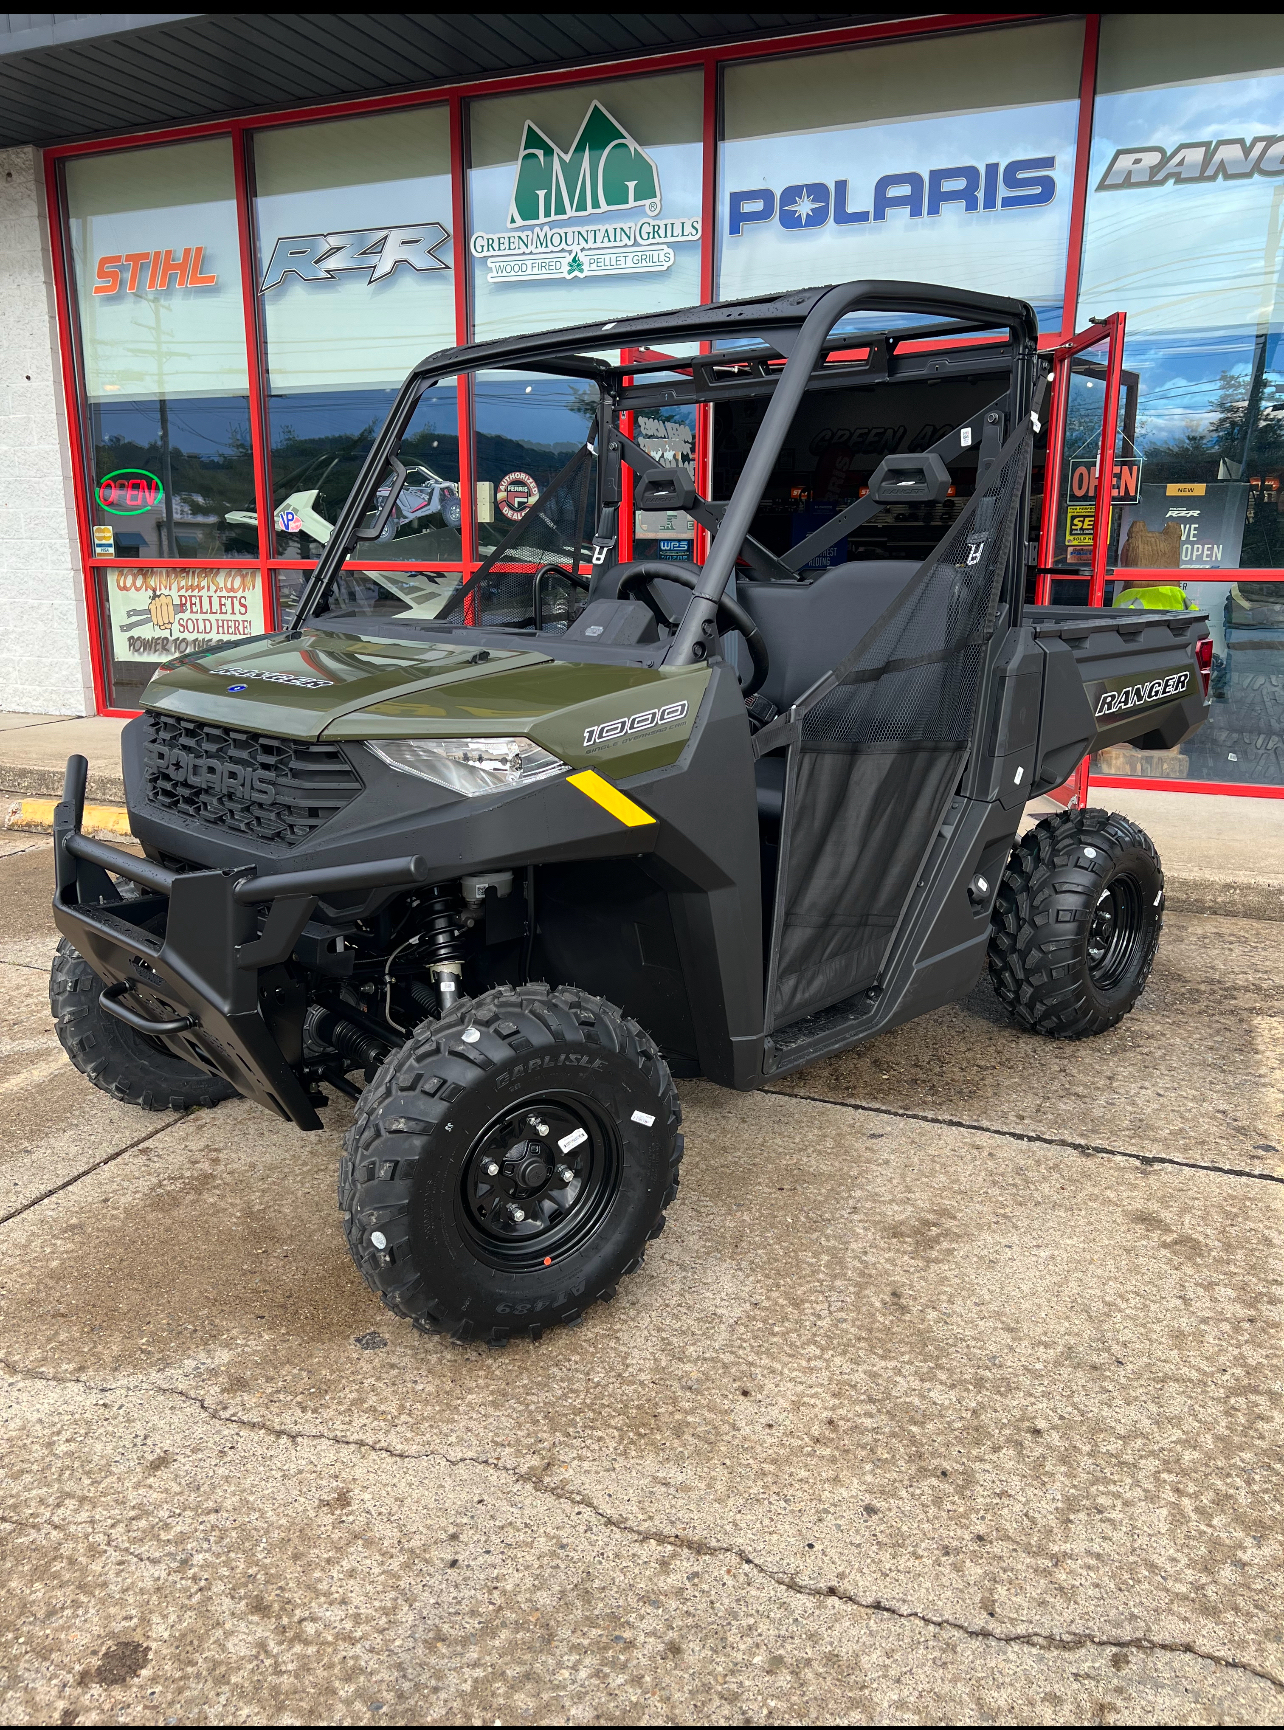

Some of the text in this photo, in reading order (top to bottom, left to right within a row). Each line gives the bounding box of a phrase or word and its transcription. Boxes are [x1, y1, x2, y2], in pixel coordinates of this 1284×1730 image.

[508, 124, 652, 225] GMG
[728, 155, 1057, 237] POLARIS
[472, 220, 700, 254] GREEN MOUNTAIN GRILLS
[93, 245, 216, 295] STIHL
[258, 222, 452, 296] RZR
[494, 251, 671, 275] WOOD FIRED PELLET GRILLS
[99, 480, 156, 506] OPEN
[499, 472, 538, 494] AUTHORIZED
[280, 511, 294, 531] VP
[1072, 517, 1095, 529] SE
[660, 541, 688, 550] WPS
[1181, 544, 1223, 561] OPEN
[116, 569, 257, 593] COOKINPELLETS.COM
[178, 595, 248, 615] PELLETS
[177, 618, 252, 636] SOLD HERE!
[127, 635, 169, 654] POWER
[172, 636, 189, 653] TO
[1095, 671, 1190, 717] RANGER
[583, 700, 689, 747] 1000
[585, 742, 619, 755] SINGLE
[152, 743, 276, 805] POLARIS
[495, 1053, 609, 1091] CARLISLE
